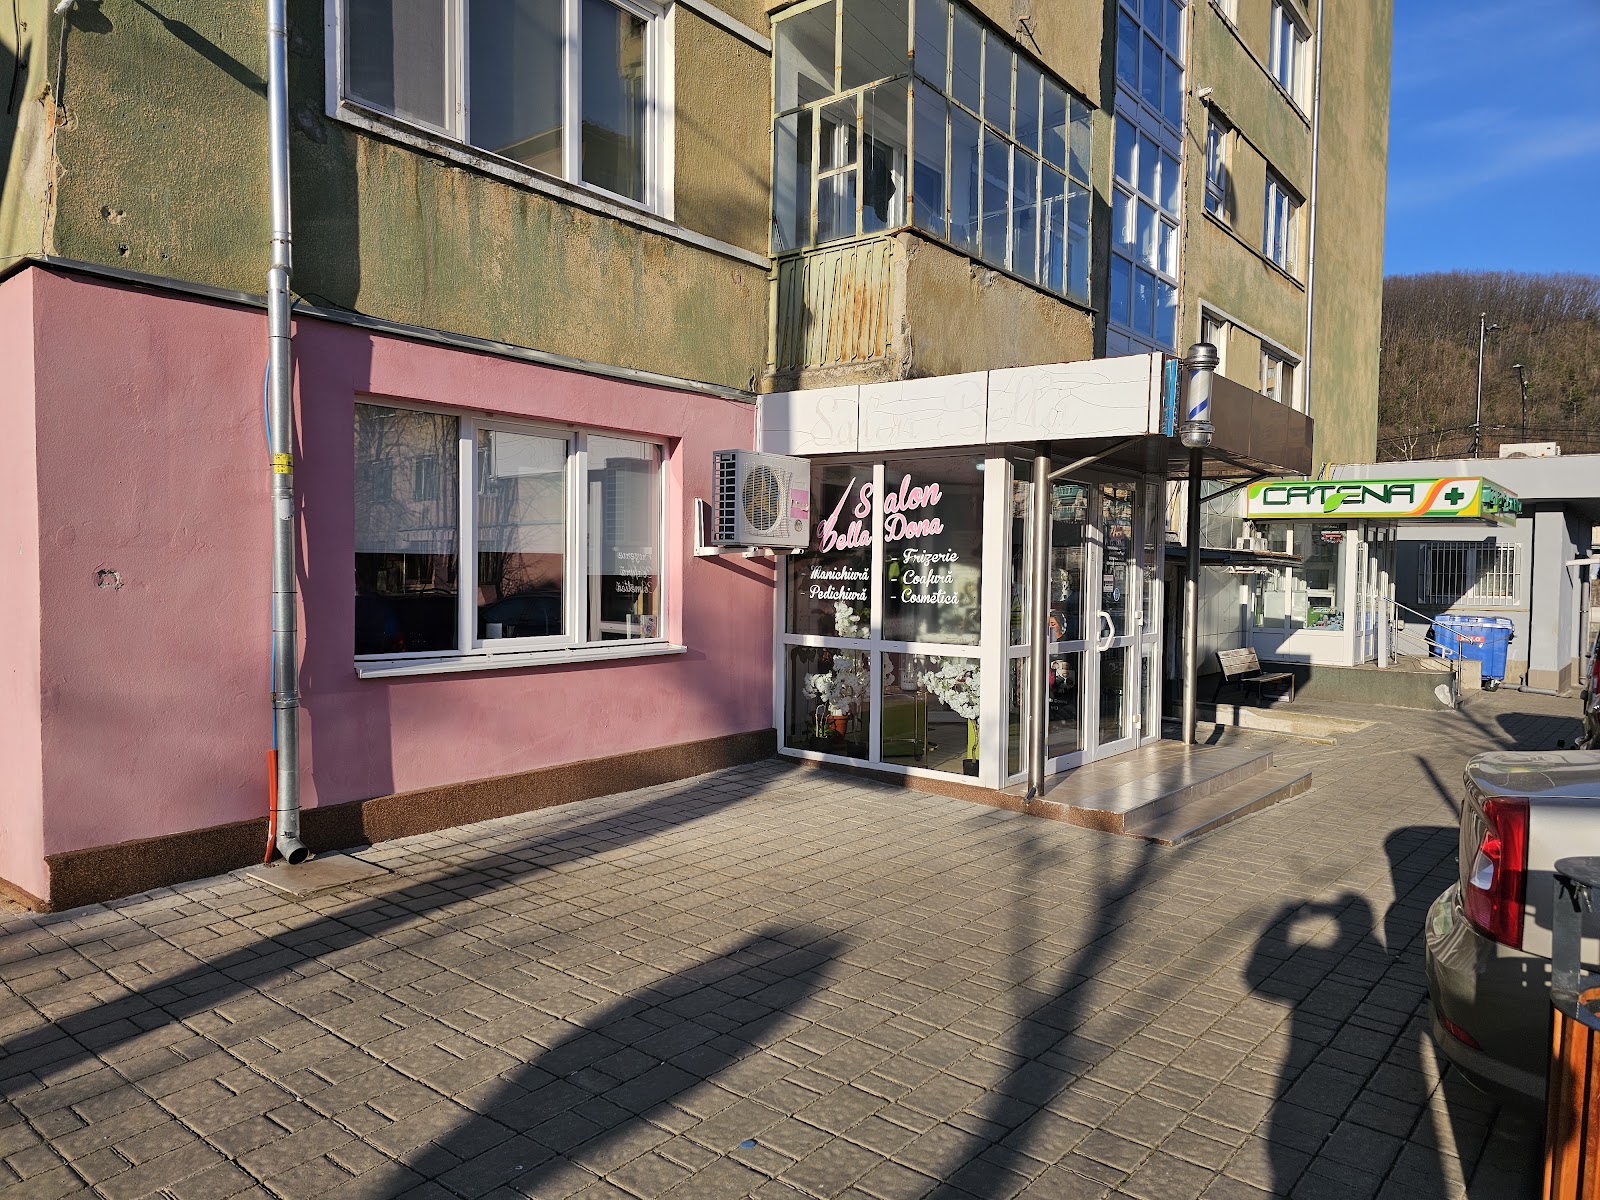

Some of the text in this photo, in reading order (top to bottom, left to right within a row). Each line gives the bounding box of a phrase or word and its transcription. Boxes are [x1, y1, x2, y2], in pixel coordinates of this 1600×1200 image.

[855, 474, 942, 519] Salon
[1263, 484, 1415, 511] CATENA
[885, 513, 944, 542] Dona
[903, 548, 959, 566] Frizerie
[810, 565, 869, 581] Manichiură
[903, 568, 953, 587] Coafură
[809, 584, 867, 601] Pedichiură
[901, 588, 959, 604] Cosmetică
